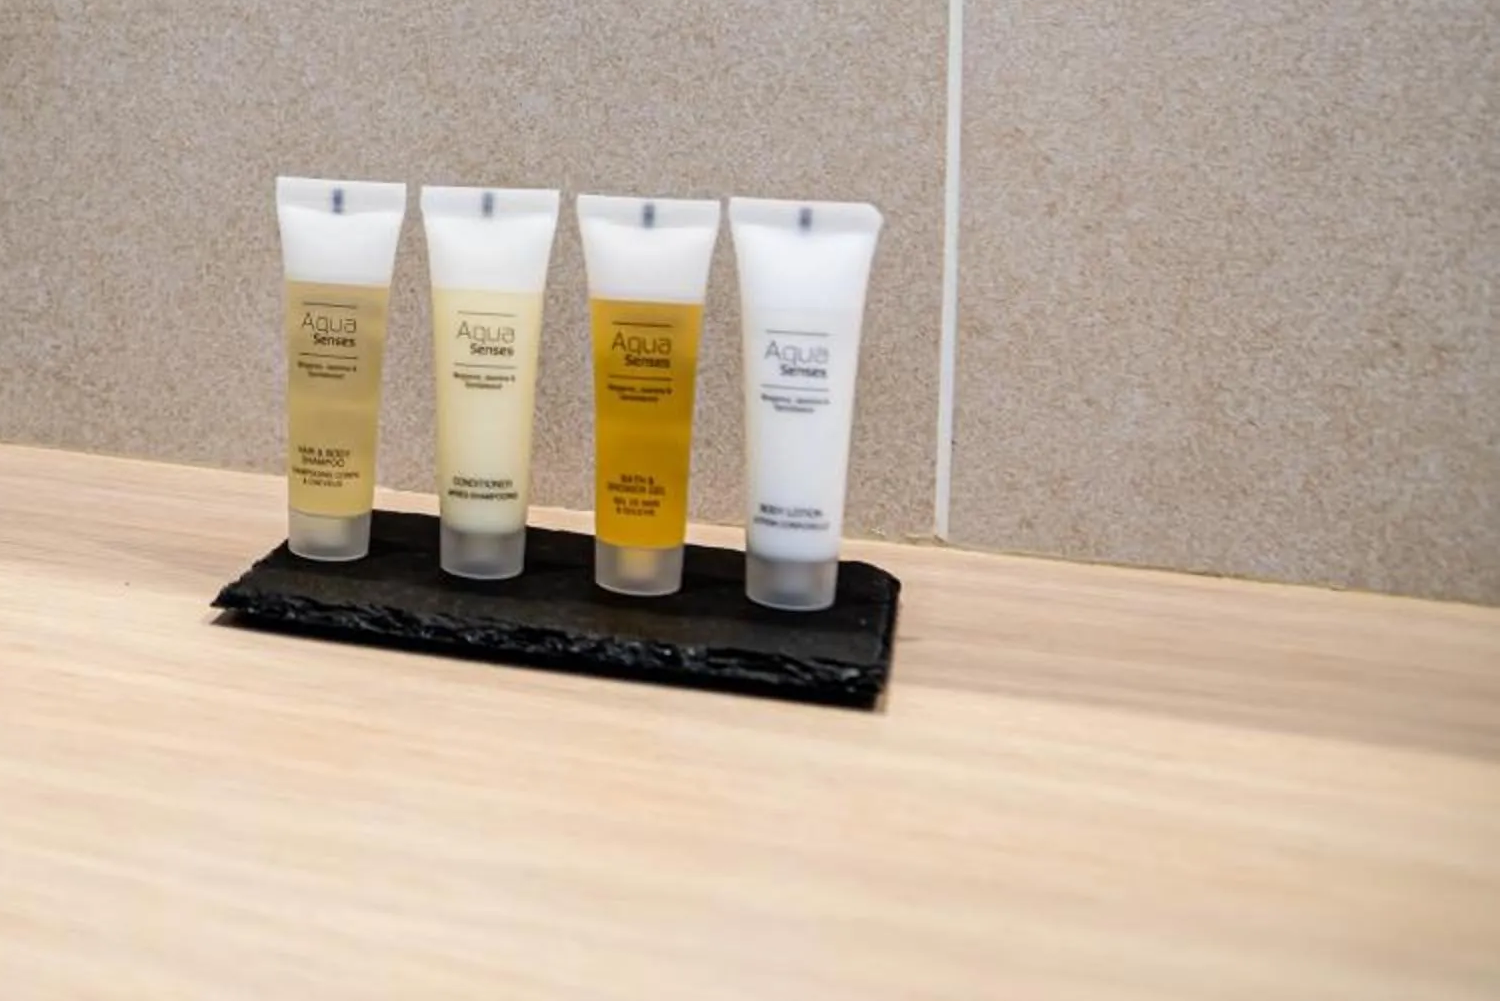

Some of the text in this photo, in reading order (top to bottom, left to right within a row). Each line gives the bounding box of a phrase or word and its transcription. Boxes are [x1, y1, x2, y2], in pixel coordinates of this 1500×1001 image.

[301, 312, 357, 334] Aqua
[313, 332, 357, 348] Senses
[456, 321, 516, 345] Aqua
[470, 343, 515, 357] Senses
[611, 331, 672, 355] Aqua
[764, 340, 829, 365] Aqua
[624, 354, 671, 369] Senses
[779, 364, 828, 379] Senses
